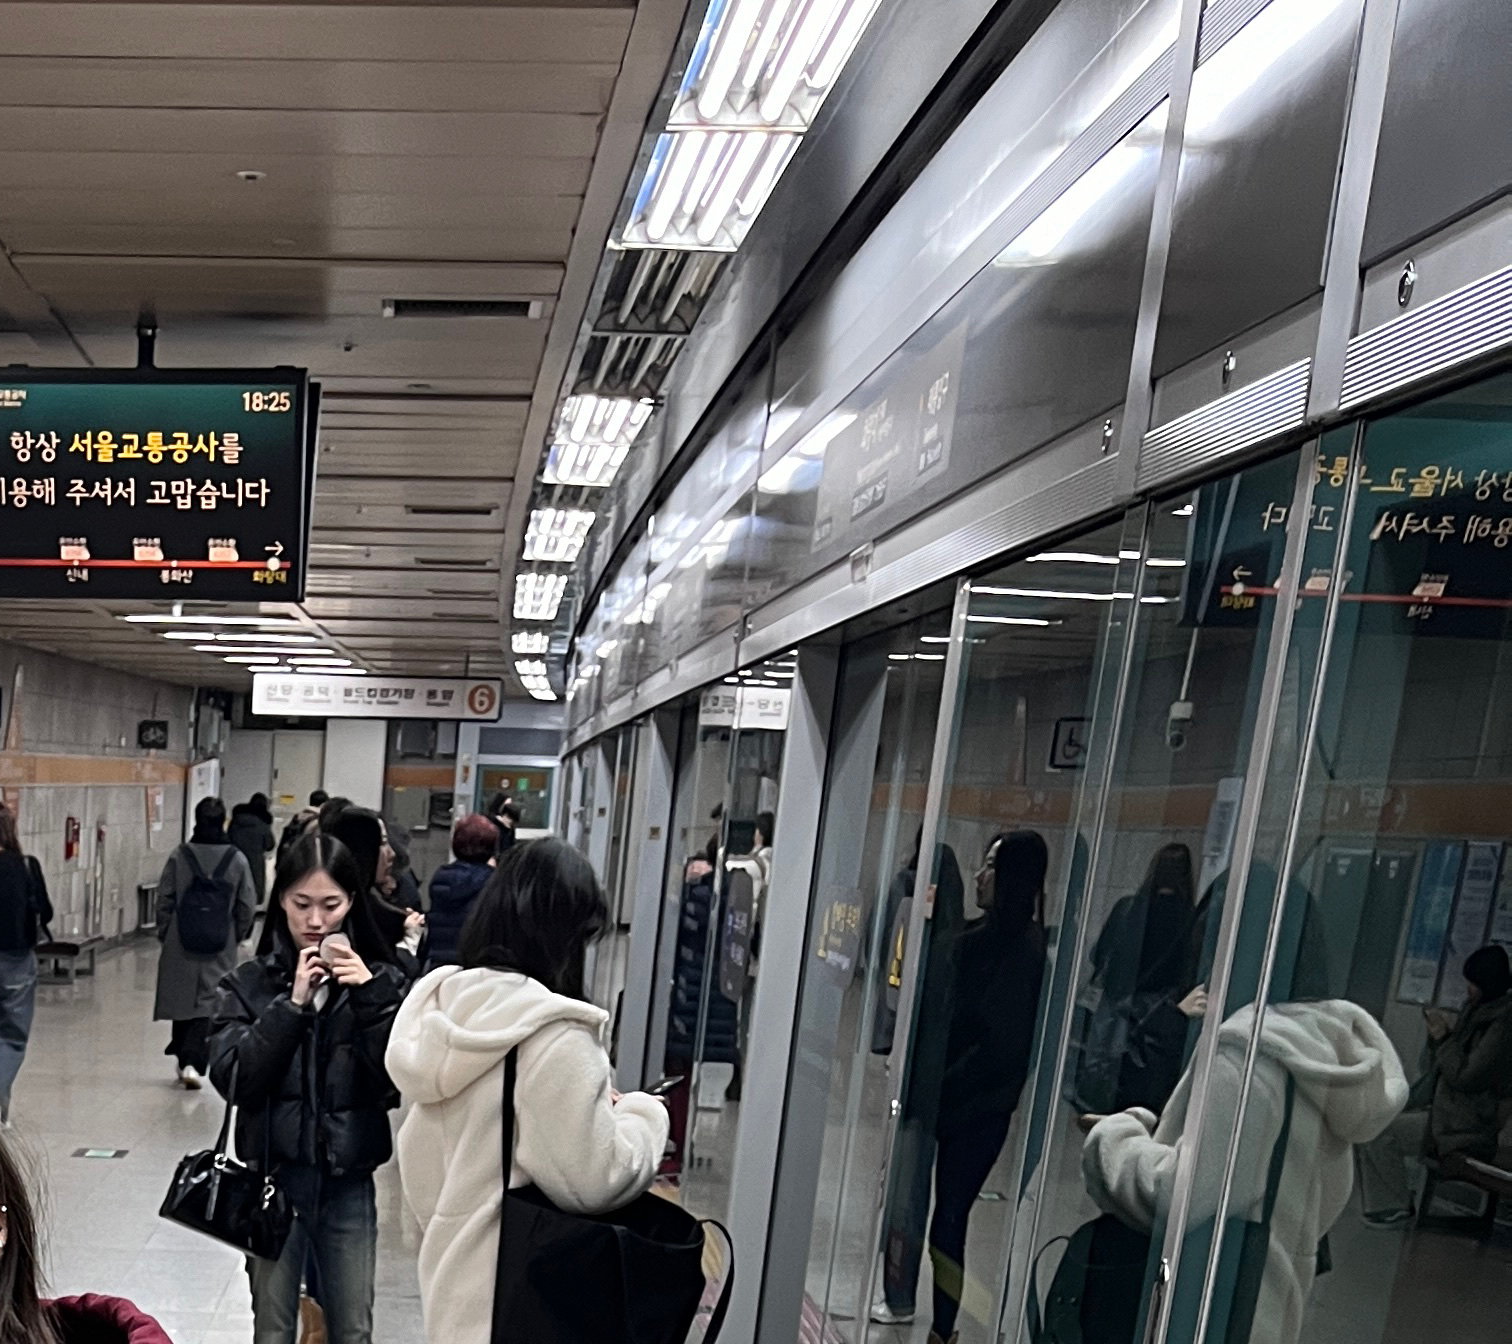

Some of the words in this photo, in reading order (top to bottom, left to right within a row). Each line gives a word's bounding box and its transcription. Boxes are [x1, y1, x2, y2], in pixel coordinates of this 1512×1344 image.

[242, 391, 291, 412] 18:25
[10, 430, 61, 462] 항상
[68, 431, 244, 464] 서울교통공사를
[65, 477, 136, 507] 주셔서
[145, 478, 271, 509] 고맙습니다
